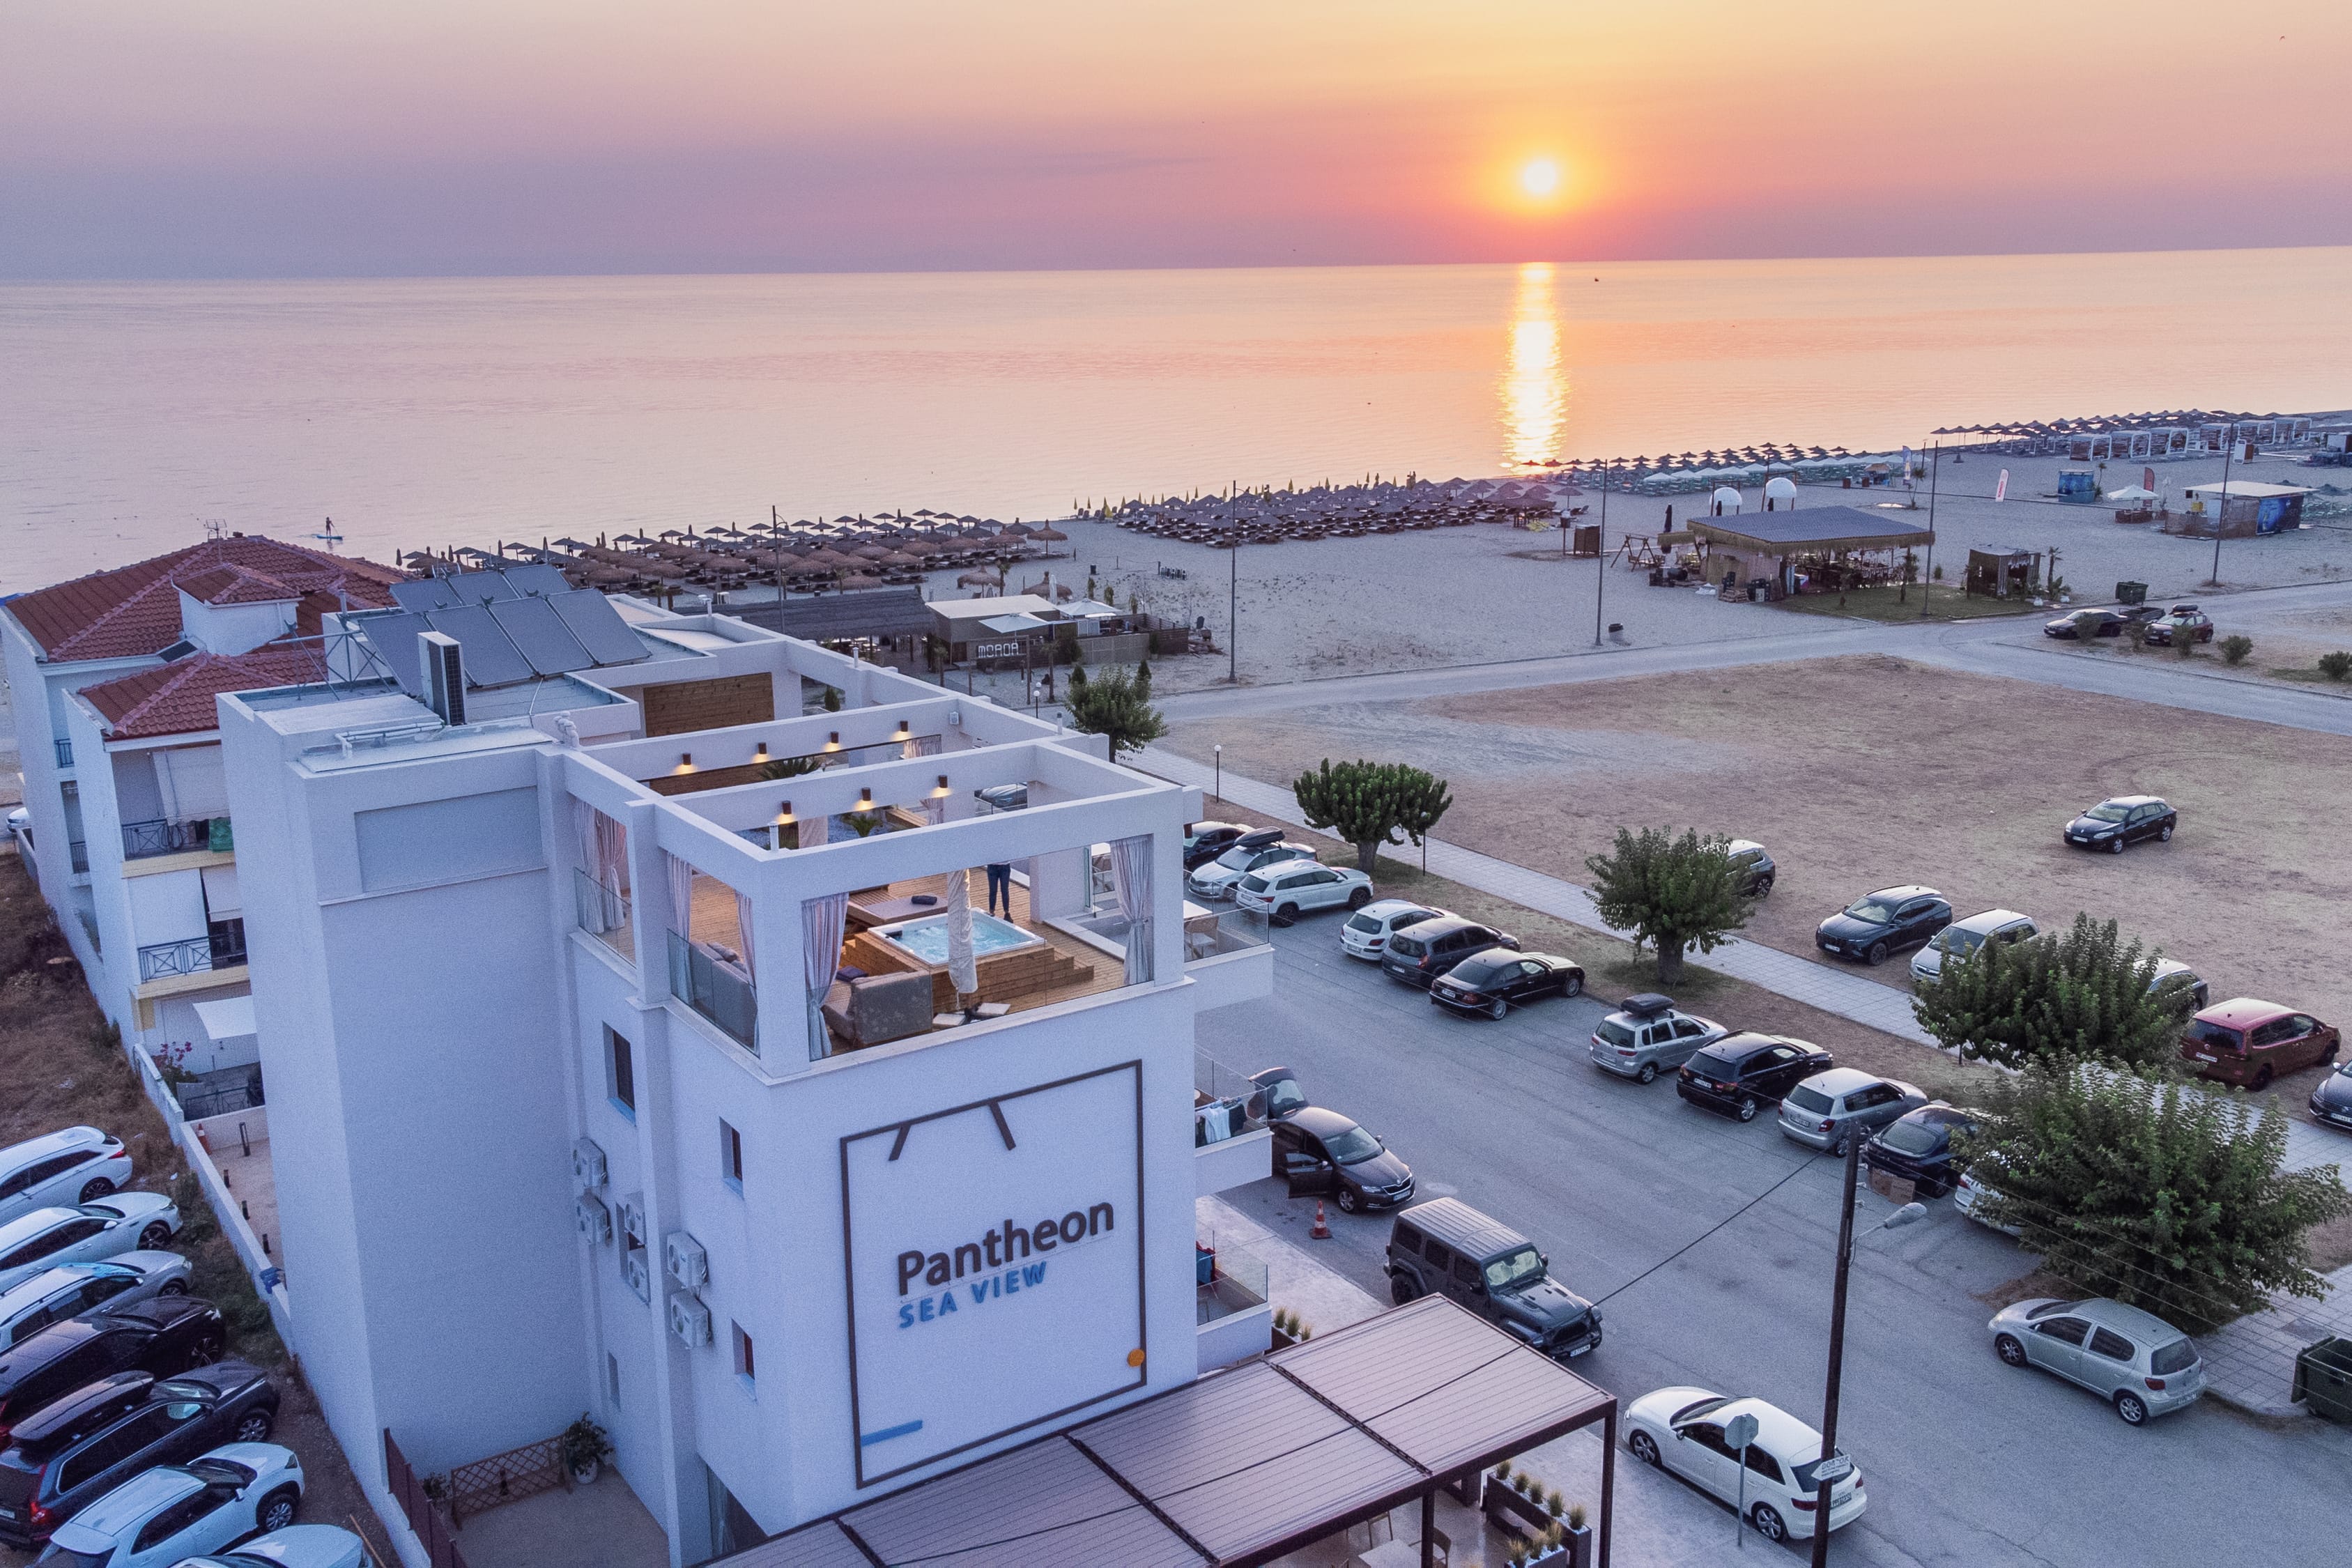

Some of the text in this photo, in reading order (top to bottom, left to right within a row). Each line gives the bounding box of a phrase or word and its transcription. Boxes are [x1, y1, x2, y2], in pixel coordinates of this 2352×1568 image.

[898, 1201, 1114, 1296] Pantheon
[899, 1261, 1047, 1328] SEA VIEW
